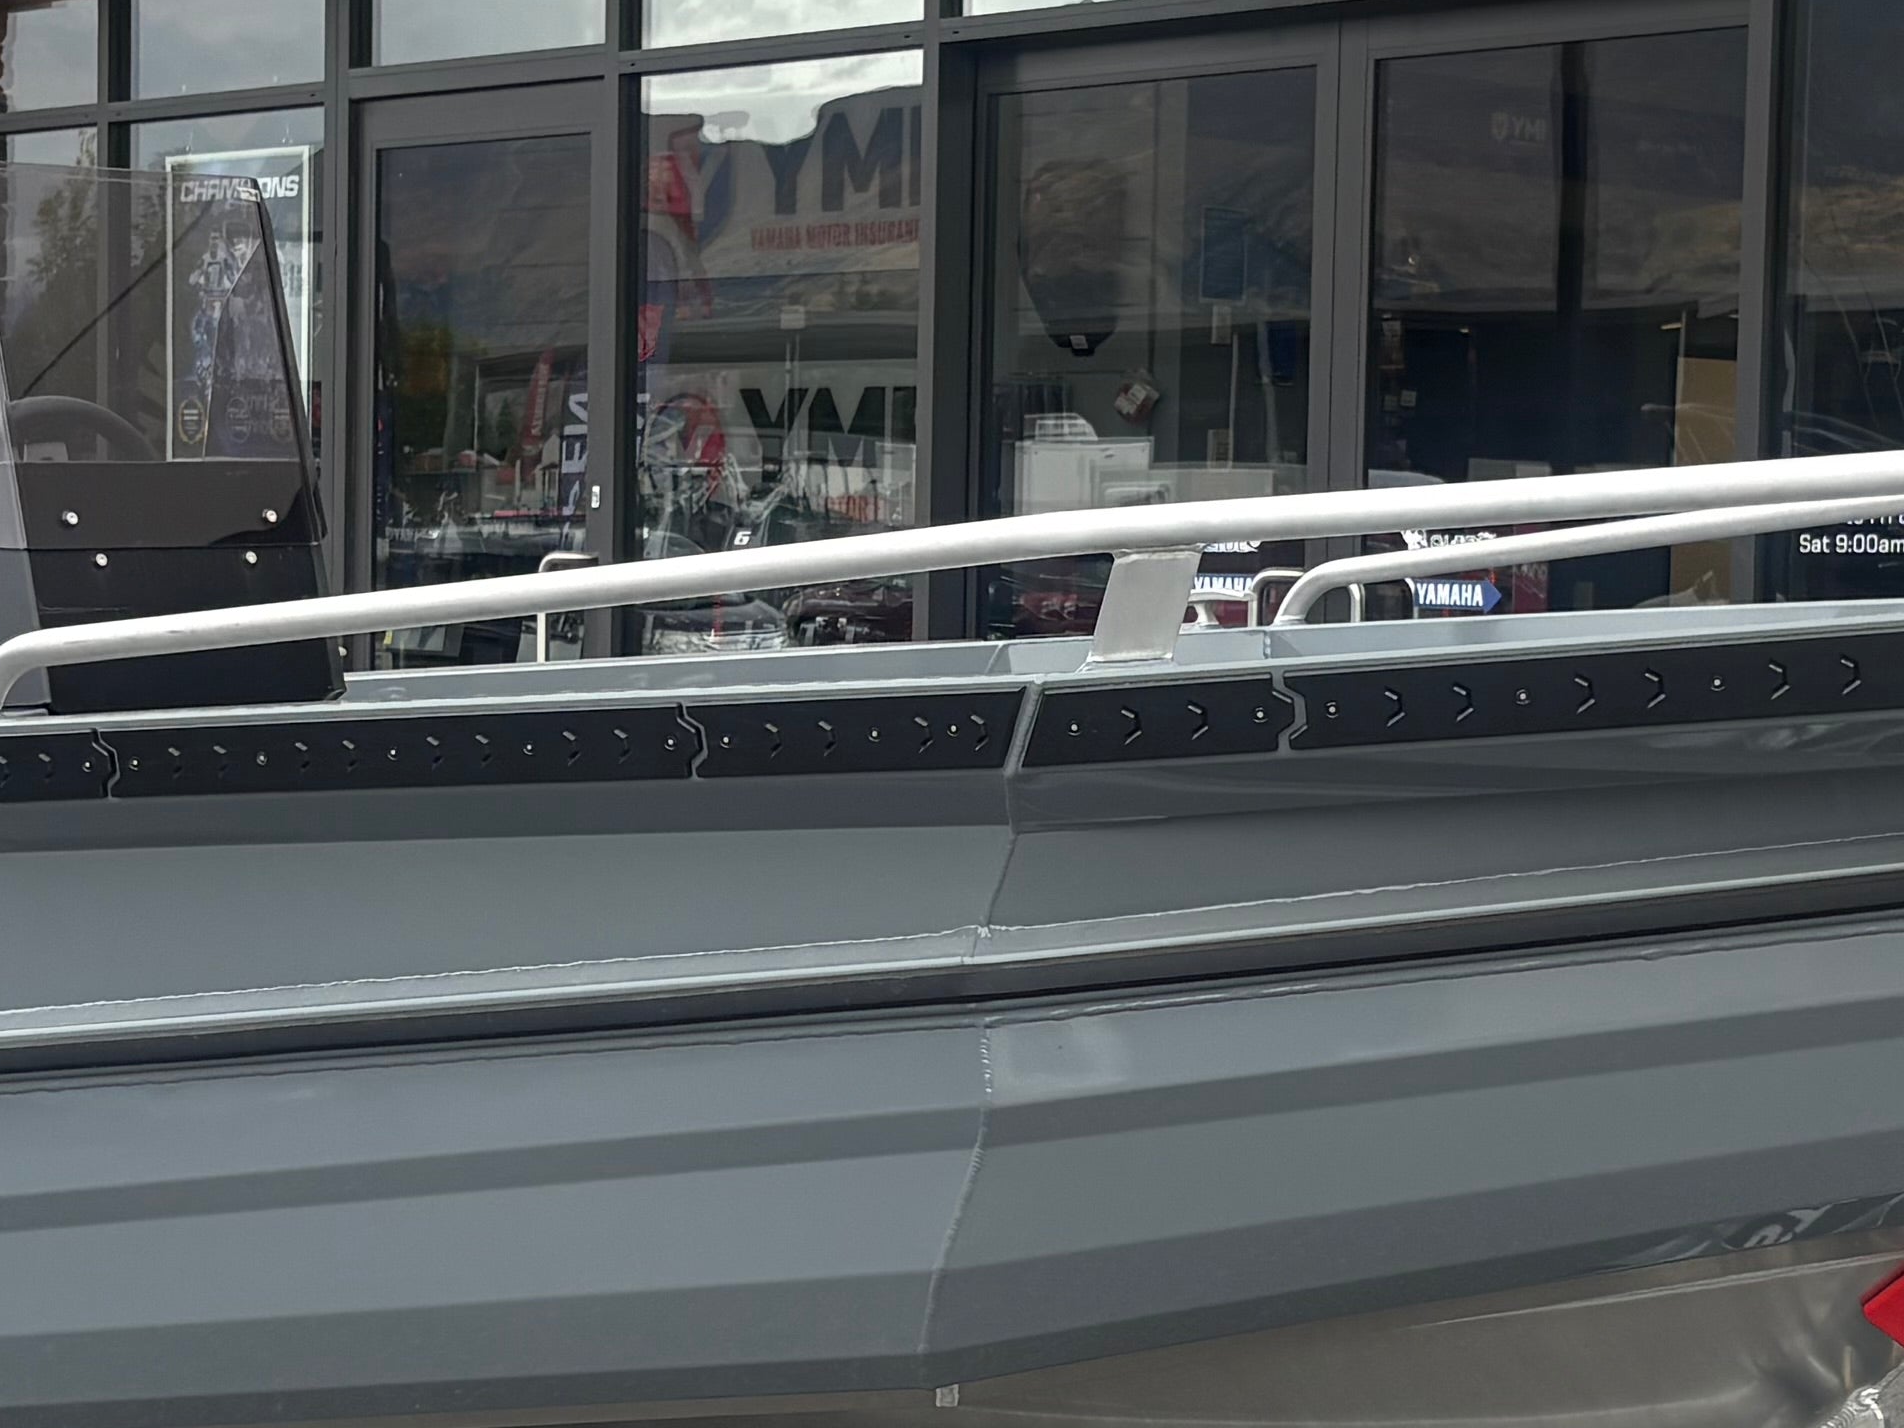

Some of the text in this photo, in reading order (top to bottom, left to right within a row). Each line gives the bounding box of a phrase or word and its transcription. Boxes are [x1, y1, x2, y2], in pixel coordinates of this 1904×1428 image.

[180, 175, 300, 202] CHAMONS
[751, 227, 801, 251] YAMAHA
[1799, 533, 1831, 554] Sat
[1416, 582, 1484, 606] YAMAHA
